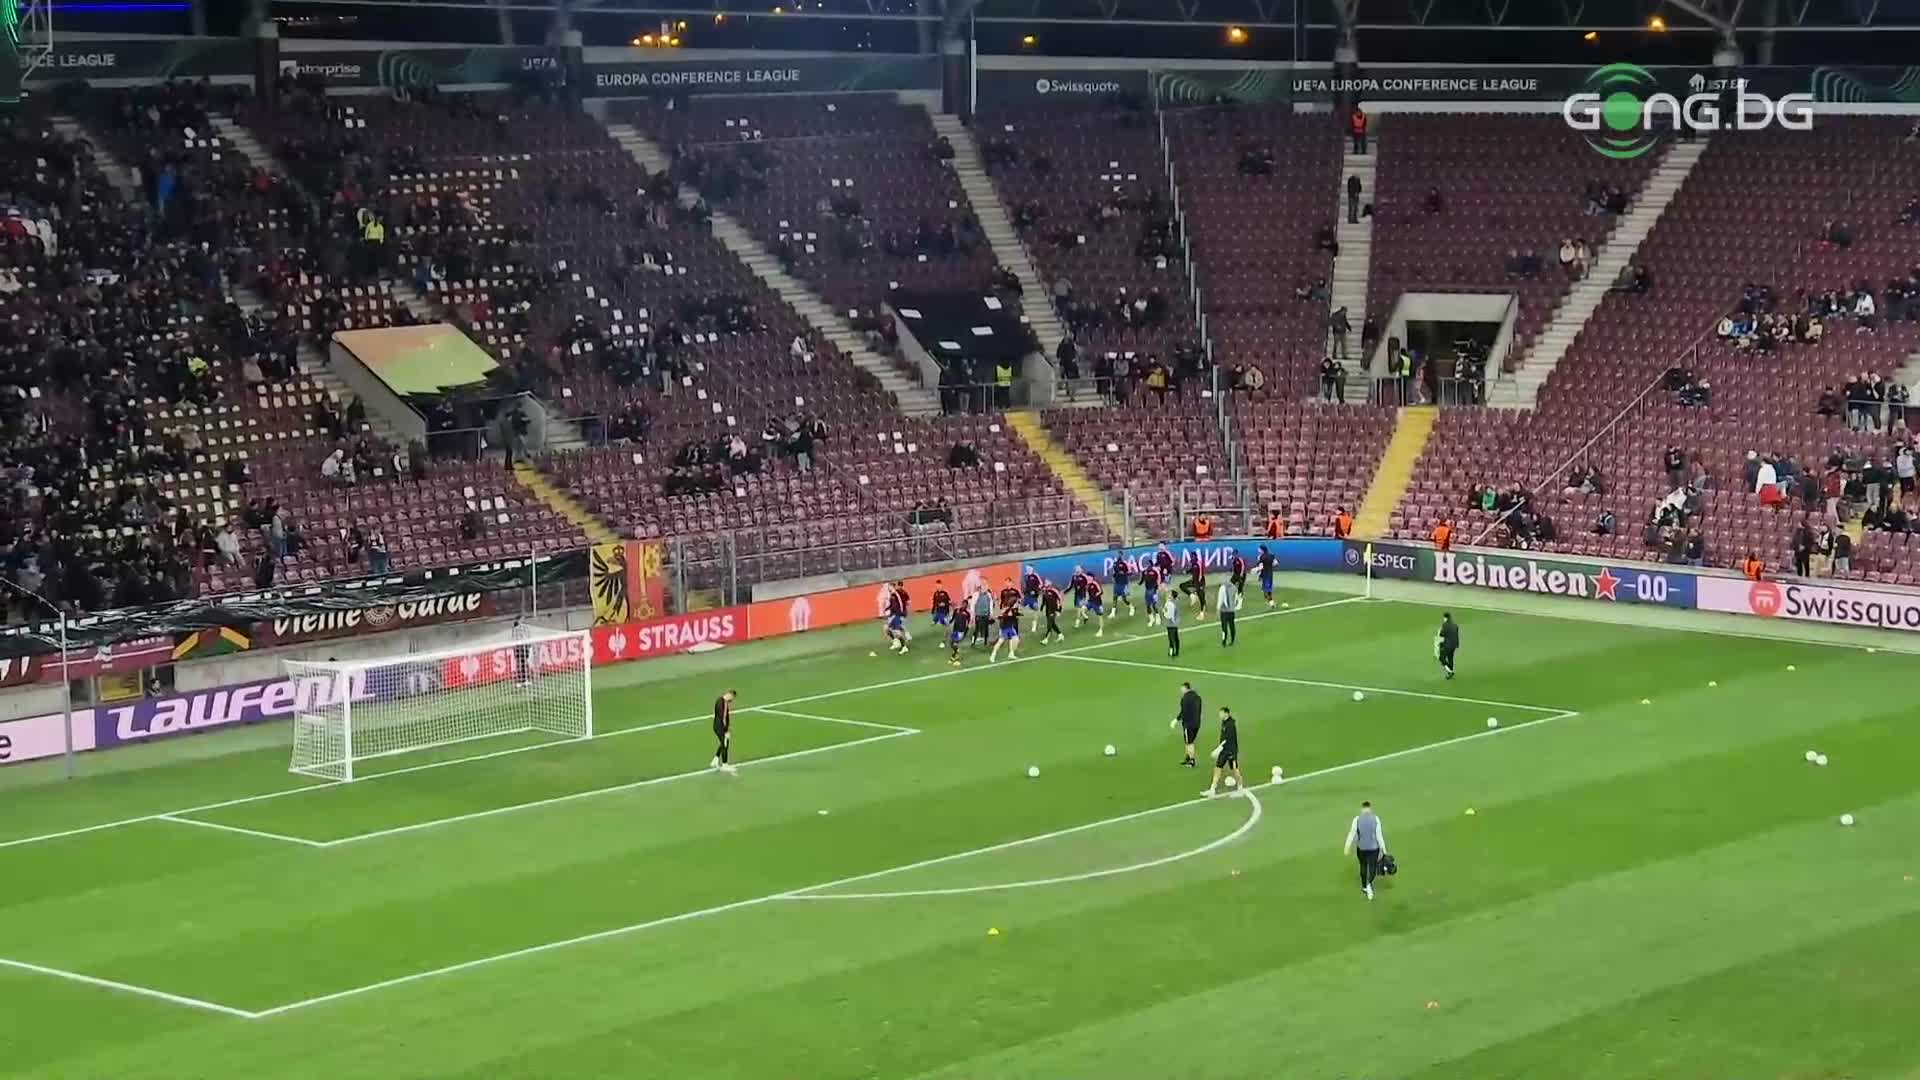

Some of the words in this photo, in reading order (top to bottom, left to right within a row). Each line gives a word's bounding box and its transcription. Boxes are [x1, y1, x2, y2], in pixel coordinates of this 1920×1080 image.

[60, 54, 115, 67] LEAGUE
[280, 60, 361, 77] nterprise
[596, 73, 648, 86] EUROPA
[651, 71, 741, 85] CONFERENCE
[746, 69, 800, 83] LEAGUE
[1293, 79, 1327, 92] UEFA
[1331, 79, 1379, 91] EUROPA
[1383, 79, 1478, 91] CONFERENCE
[1482, 79, 1537, 91] LEAGUE
[1050, 80, 1120, 95] Swissquote
[1434, 551, 1588, 596] Heineken
[638, 614, 735, 651] STRAUSS
